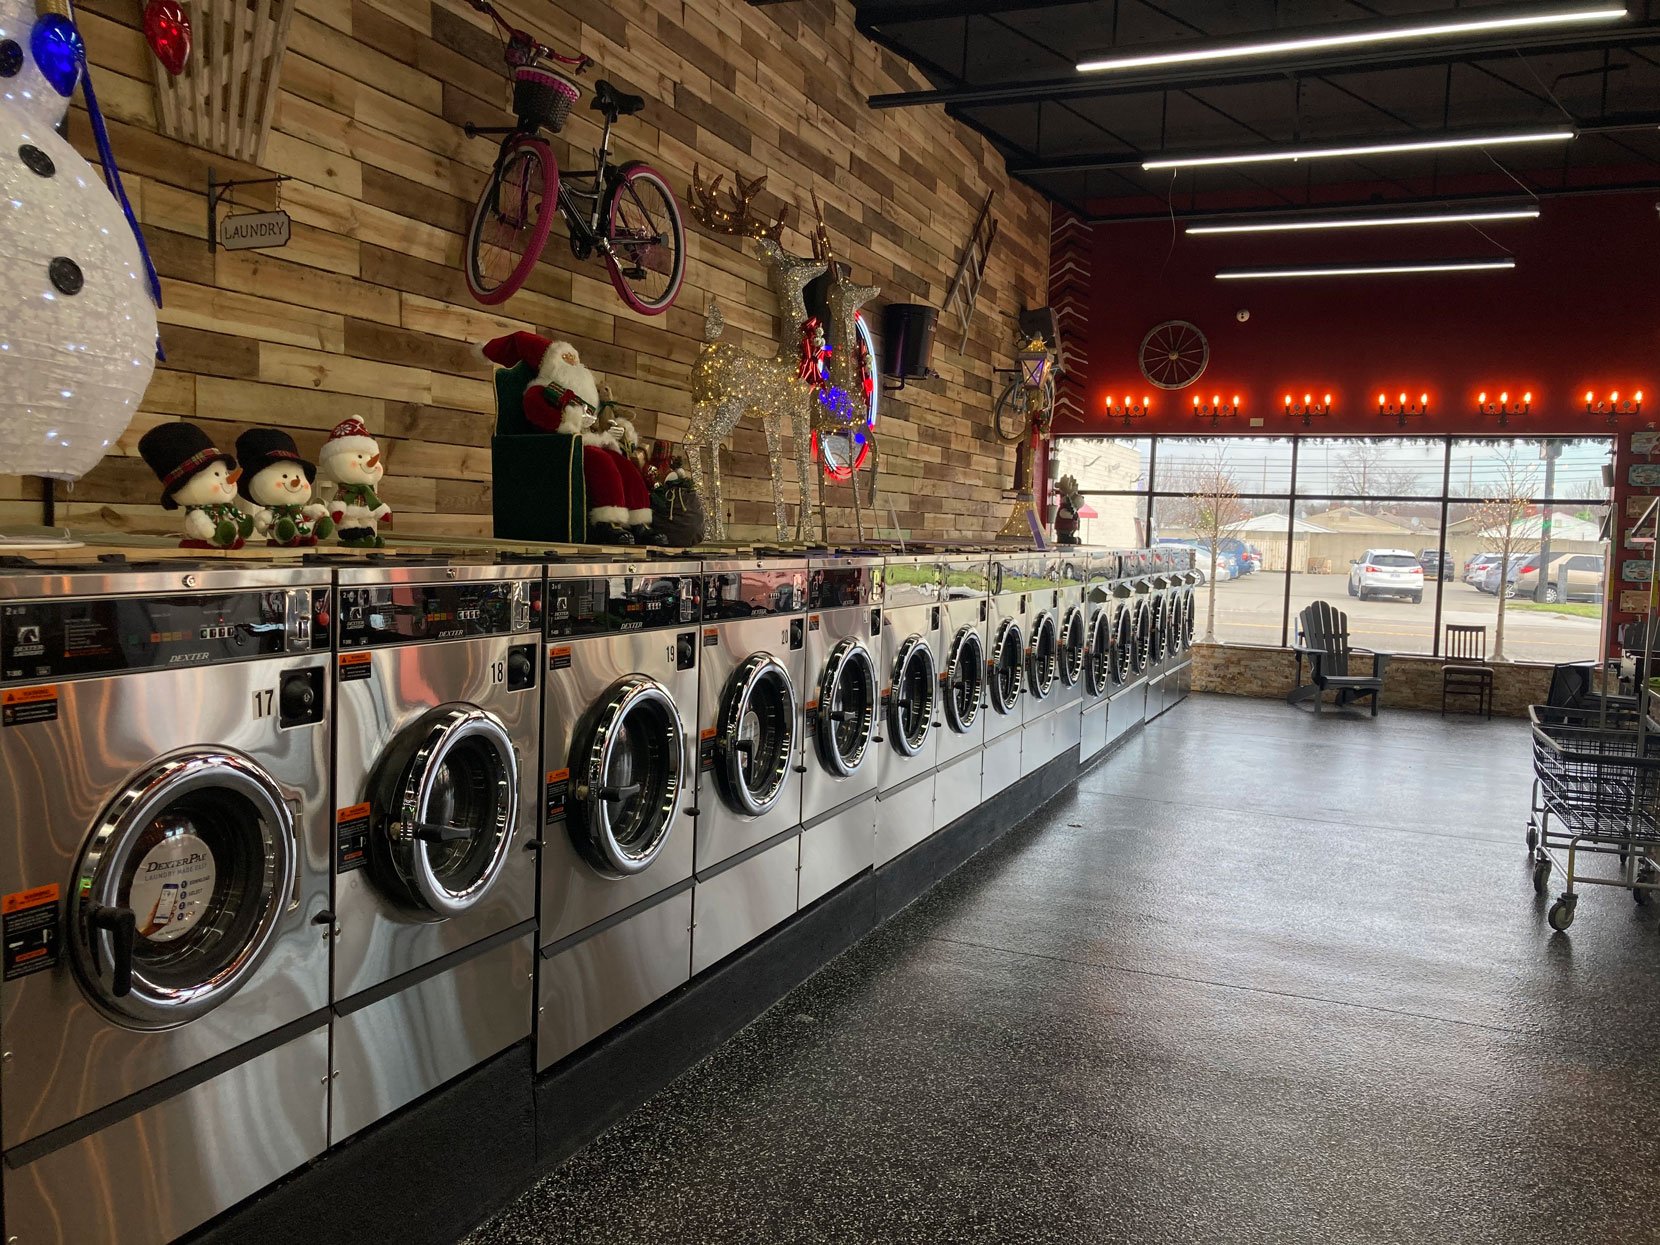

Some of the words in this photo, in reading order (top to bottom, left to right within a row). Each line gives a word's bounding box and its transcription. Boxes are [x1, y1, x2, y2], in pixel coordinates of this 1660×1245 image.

[224, 221, 285, 240] LAUNDRY
[438, 629, 464, 638] DEXTER
[620, 622, 643, 630] DEXTER
[781, 629, 789, 645] 20
[169, 652, 210, 663] DEXTER
[666, 645, 675, 663] 19
[491, 661, 504, 684] 18
[255, 689, 274, 717] 17
[144, 870, 176, 881] LAUNDRY
[177, 866, 194, 875] MADE
